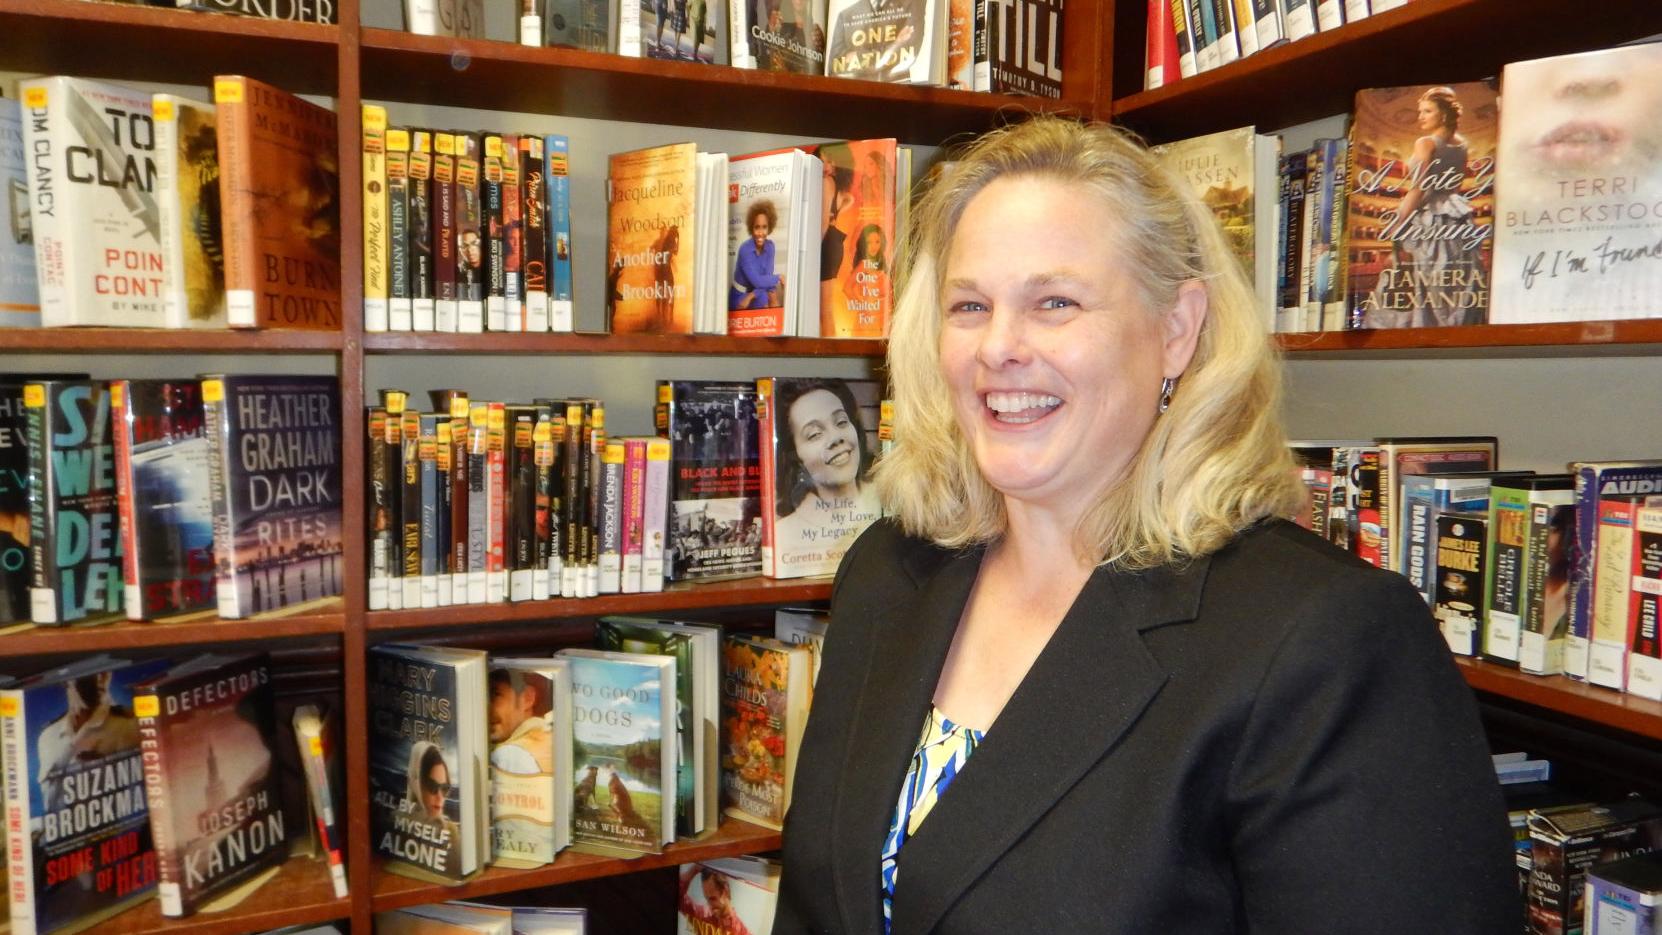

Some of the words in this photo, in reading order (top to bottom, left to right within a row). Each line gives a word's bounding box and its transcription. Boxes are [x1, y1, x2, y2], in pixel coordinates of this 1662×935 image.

[752, 25, 786, 46] Cookie
[787, 39, 823, 62] Johnson
[852, 24, 897, 46] ONE
[832, 46, 915, 73] NATION
[992, 67, 1027, 89] TIMOTHY
[34, 139, 55, 218] CLANCY
[740, 180, 786, 198] Differently
[1557, 176, 1638, 198] TERRI
[613, 180, 684, 206] Jacqueline
[393, 199, 404, 242] ASHLEY
[620, 213, 685, 233] Woodson
[1377, 209, 1492, 251] Unsung
[613, 247, 671, 268] Another
[862, 259, 879, 270] The
[1521, 251, 1546, 290] If
[1551, 250, 1589, 278] I'm
[491, 254, 499, 290] SWINSON
[856, 271, 878, 283] One
[1386, 266, 1488, 290] TAMERA
[622, 280, 687, 304] Brooklyn
[847, 298, 881, 311] Waited
[743, 315, 777, 329] BURTON
[859, 312, 876, 325] For
[237, 394, 332, 431] HEATHER
[241, 429, 335, 473] GRAHAM
[605, 463, 616, 503] BRENDA
[680, 467, 718, 480] BLACK
[721, 466, 745, 478] AND
[29, 467, 45, 540] LEHANE
[249, 471, 333, 512] DARK
[815, 498, 831, 511] My
[603, 504, 616, 549] JACKSON
[830, 511, 847, 524] My
[1311, 491, 1328, 538] FLASH
[1411, 504, 1426, 541] RAIN
[56, 510, 123, 568] DE
[257, 513, 327, 546] RITES
[802, 527, 818, 542] My
[820, 525, 858, 543] Legacy
[781, 551, 824, 565] Coretta
[1408, 545, 1425, 589] GODS
[1438, 547, 1480, 573] BURKE
[1503, 548, 1516, 612] CREOLE
[1643, 599, 1656, 614] LEE
[1641, 615, 1656, 639] CHILD
[166, 665, 269, 716] DEFECTORS
[600, 685, 650, 703] GOOD
[725, 678, 769, 707] CHILDS
[574, 705, 633, 728] DOGS
[199, 790, 269, 838] JOSEPH
[399, 798, 417, 814] BY
[393, 814, 453, 850] MYSELF,
[600, 823, 646, 838] WILSON
[46, 844, 94, 886] SOME
[100, 831, 139, 863] KIND
[183, 808, 286, 891] KANON
[378, 831, 448, 872] ALONE
